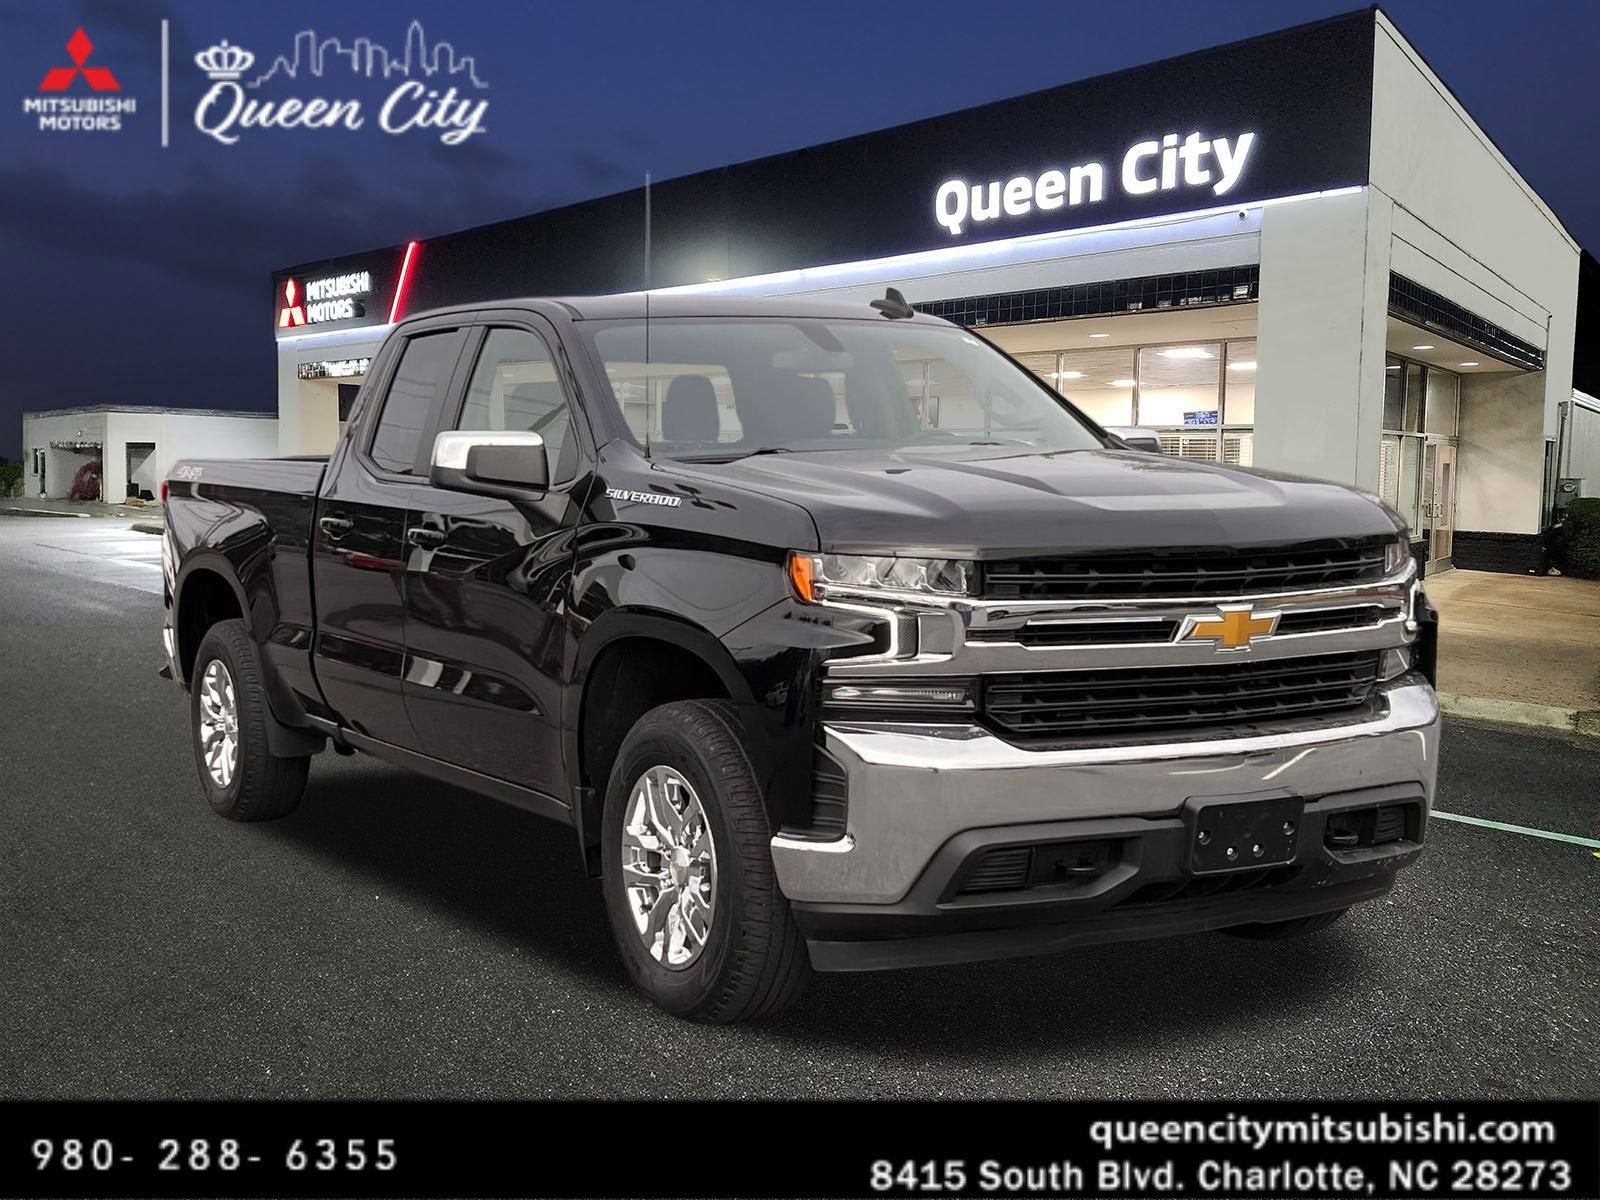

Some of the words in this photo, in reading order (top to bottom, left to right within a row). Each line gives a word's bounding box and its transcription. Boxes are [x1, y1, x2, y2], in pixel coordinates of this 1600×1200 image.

[935, 161, 1104, 235] Queen
[1121, 131, 1256, 196] City
[306, 270, 371, 301] MITSUBISHI
[306, 297, 355, 323] MOTORS
[605, 487, 682, 508] SILVERADO
